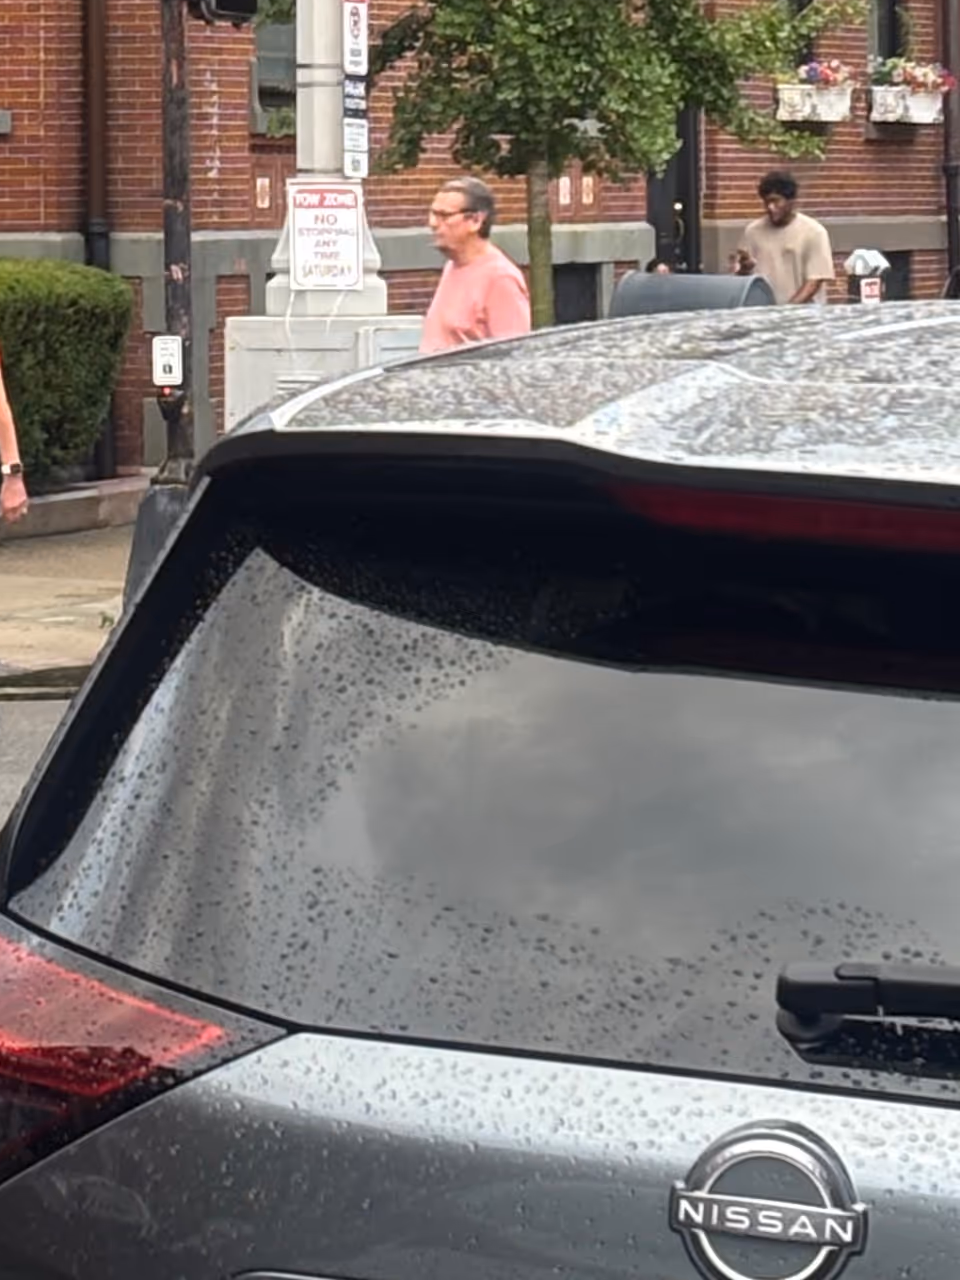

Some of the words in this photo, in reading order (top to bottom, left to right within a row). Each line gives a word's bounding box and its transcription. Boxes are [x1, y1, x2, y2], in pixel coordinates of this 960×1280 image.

[294, 193, 321, 207] TOW
[323, 193, 357, 207] ZONE
[314, 214, 338, 226] NO
[298, 227, 356, 237] STOPPING
[315, 239, 339, 249] ANY
[313, 251, 341, 261] TIME
[301, 263, 353, 279] SATURDAY
[678, 1199, 854, 1243] NISSAN
